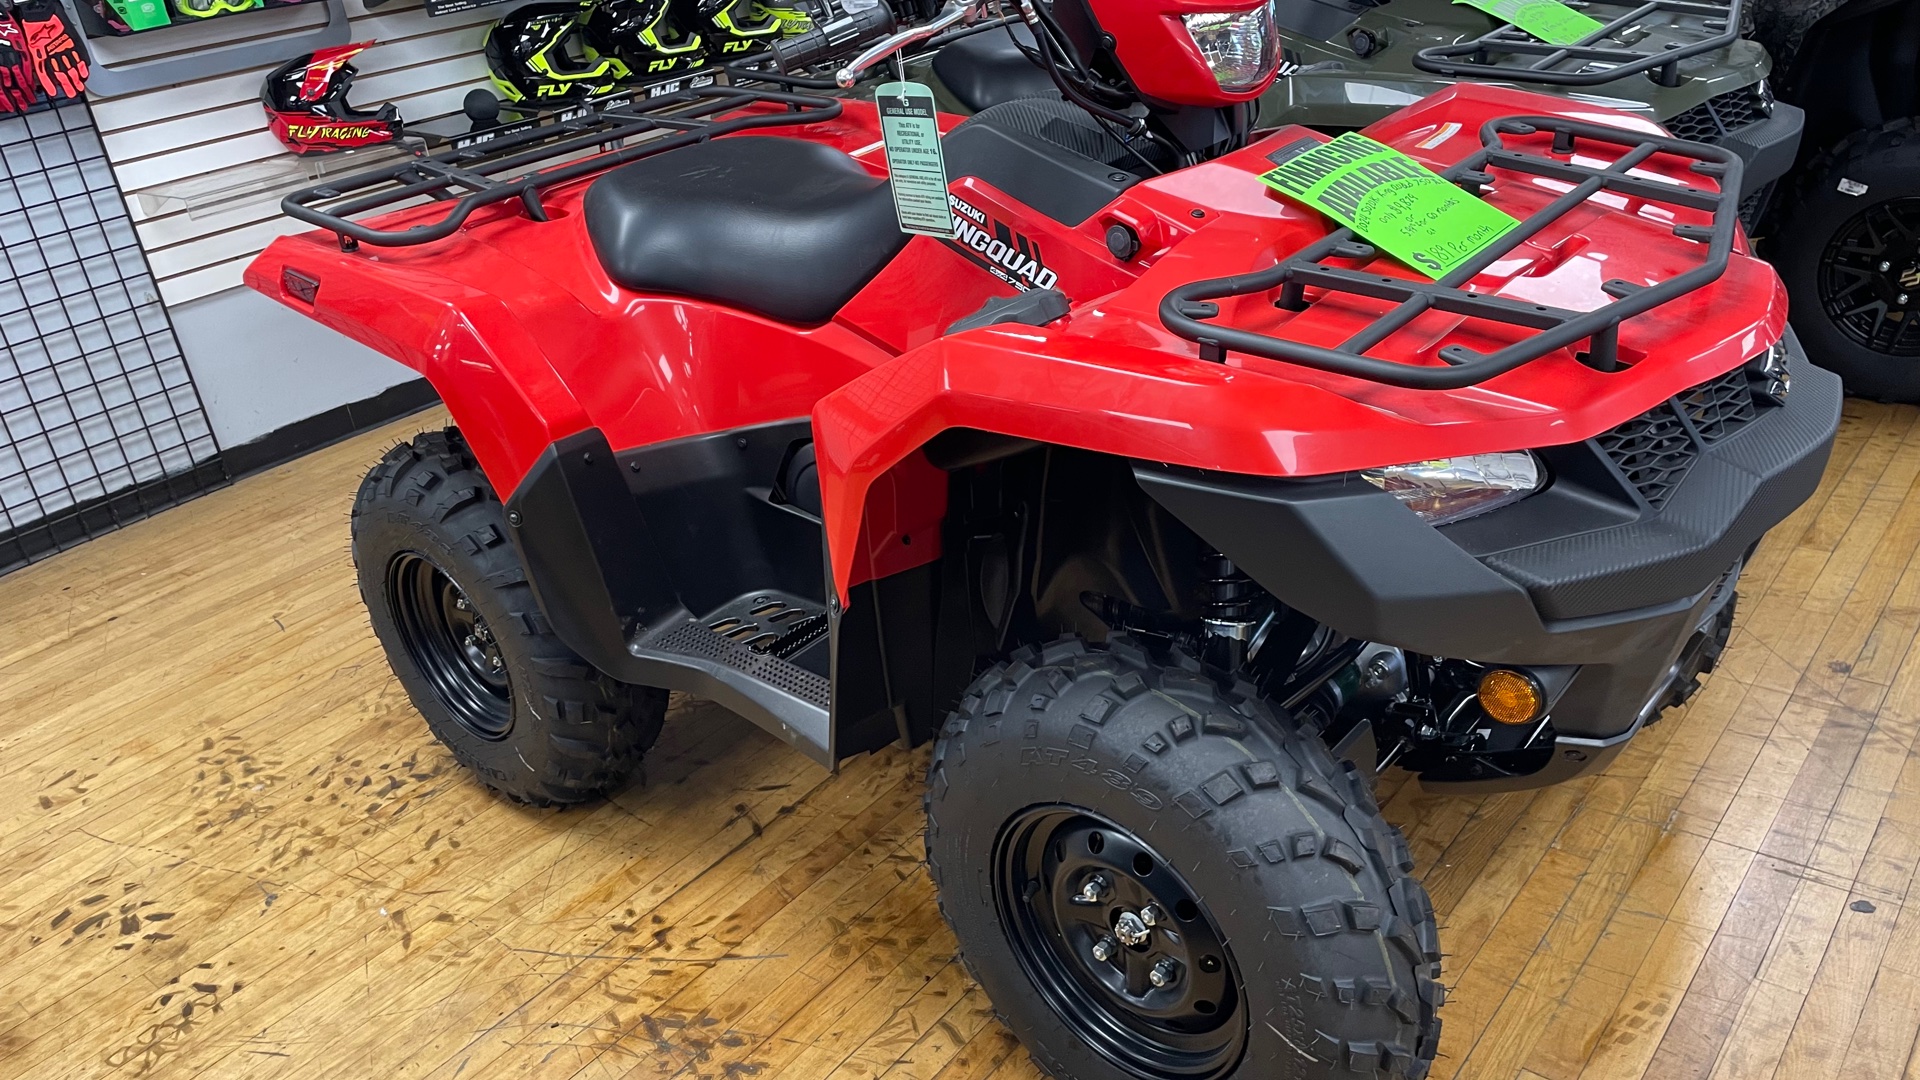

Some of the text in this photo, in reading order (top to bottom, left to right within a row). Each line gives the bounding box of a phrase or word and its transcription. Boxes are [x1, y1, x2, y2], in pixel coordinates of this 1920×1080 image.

[722, 39, 753, 53] FLY
[648, 57, 678, 73] FLY
[537, 82, 573, 97] FLY
[650, 82, 680, 98] HJC
[886, 107, 905, 115] GENERAL
[288, 125, 370, 140] FLY RACING
[1263, 134, 1389, 196] FINANCING
[1316, 156, 1437, 224] AVAILABLE
[949, 194, 986, 224] SUZUKI
[951, 212, 1059, 291] INGQUAD
